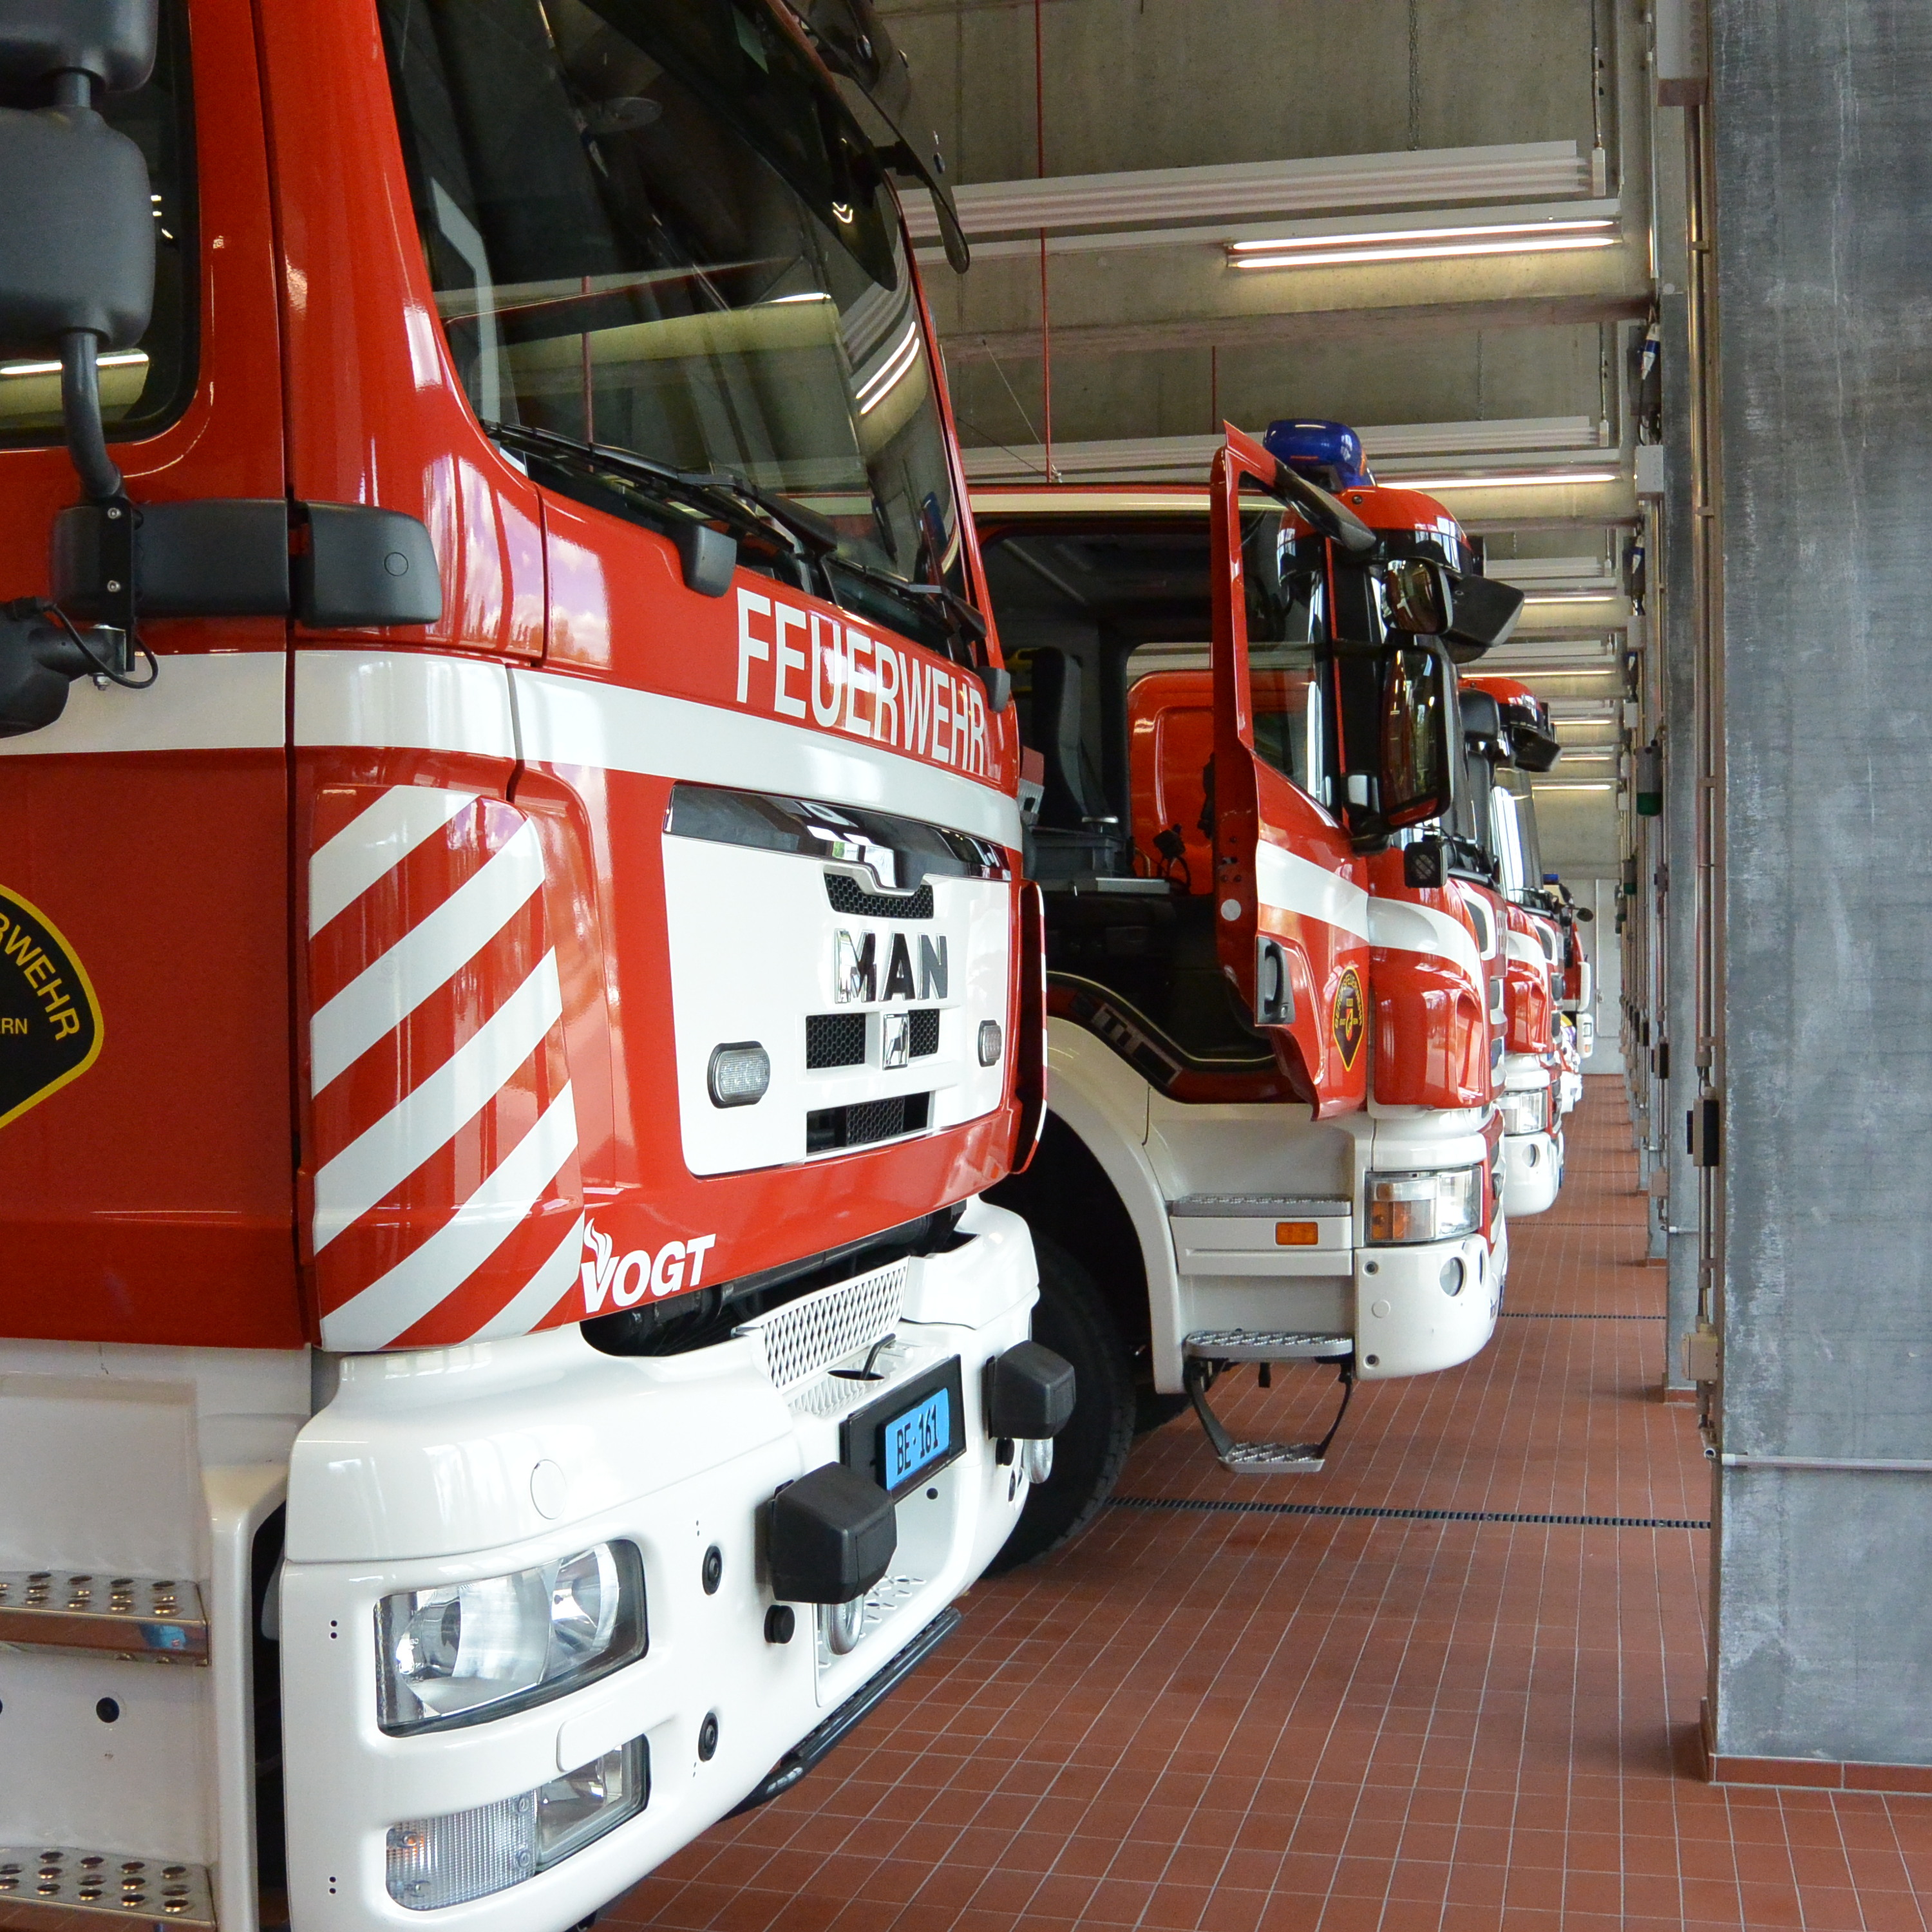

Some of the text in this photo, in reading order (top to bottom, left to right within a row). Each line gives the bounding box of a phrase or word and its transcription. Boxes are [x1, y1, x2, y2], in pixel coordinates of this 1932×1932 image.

[737, 587, 985, 777] FEUERWEHR
[835, 929, 949, 1003] MAN
[581, 1233, 716, 1314] VOGT
